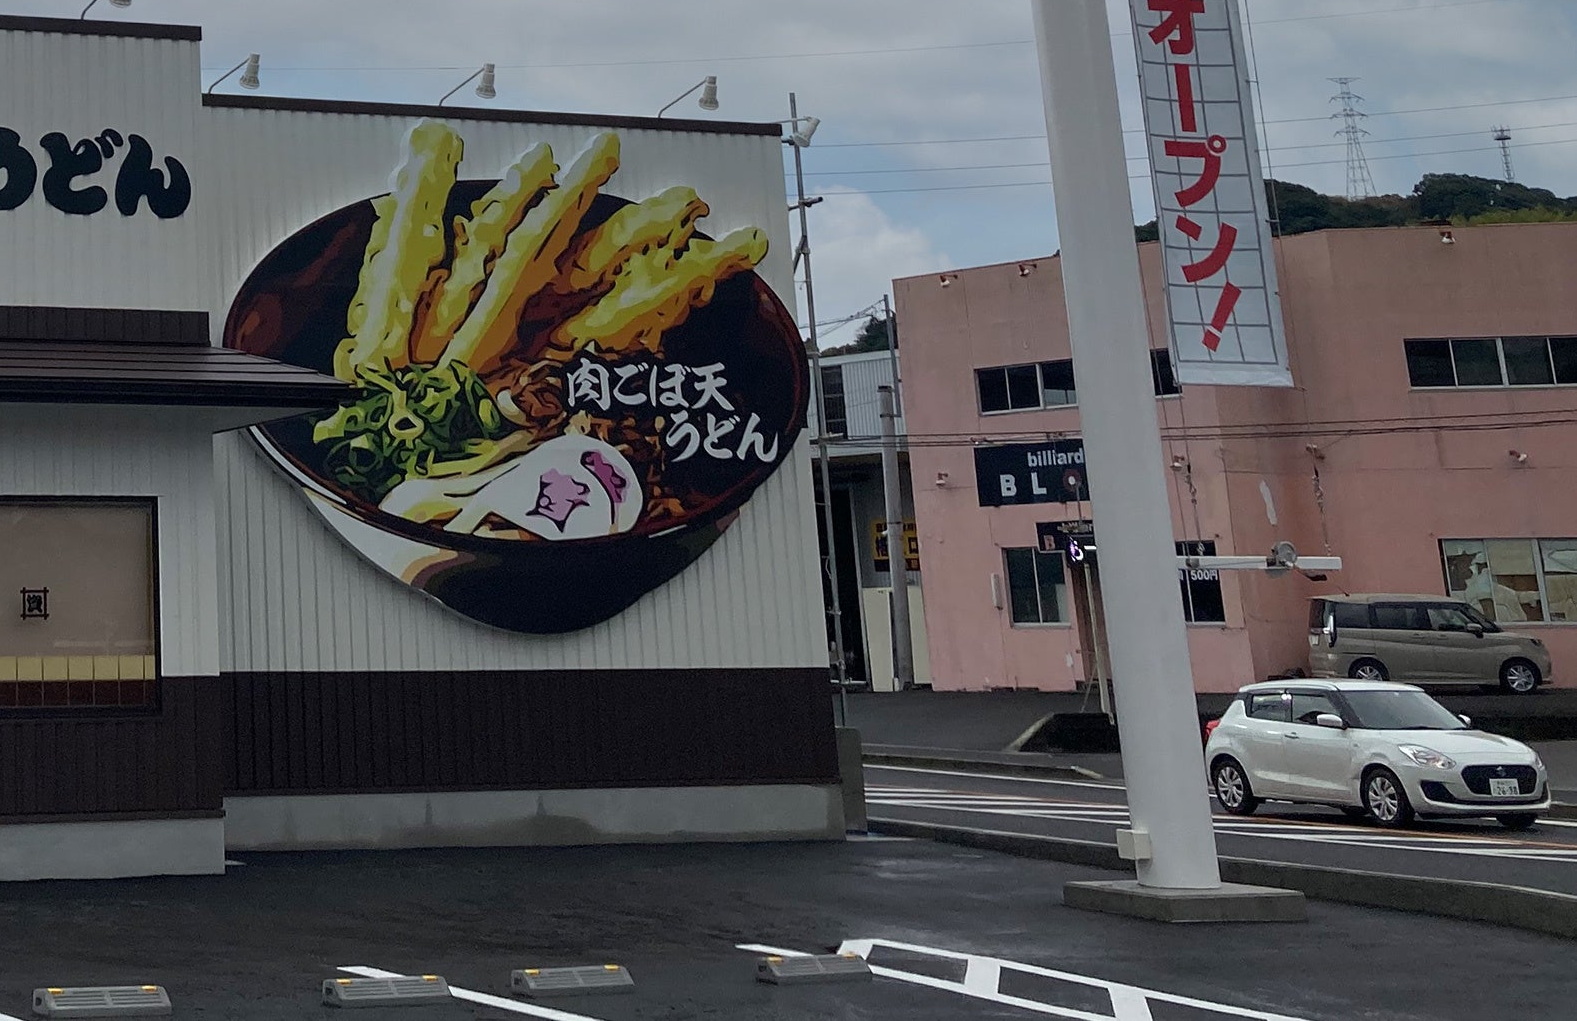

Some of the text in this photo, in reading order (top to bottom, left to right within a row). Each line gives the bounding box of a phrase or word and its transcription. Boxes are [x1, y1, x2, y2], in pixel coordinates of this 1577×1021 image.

[567, 357, 735, 411] 肉ごぼ天
[665, 409, 779, 463] うどん
